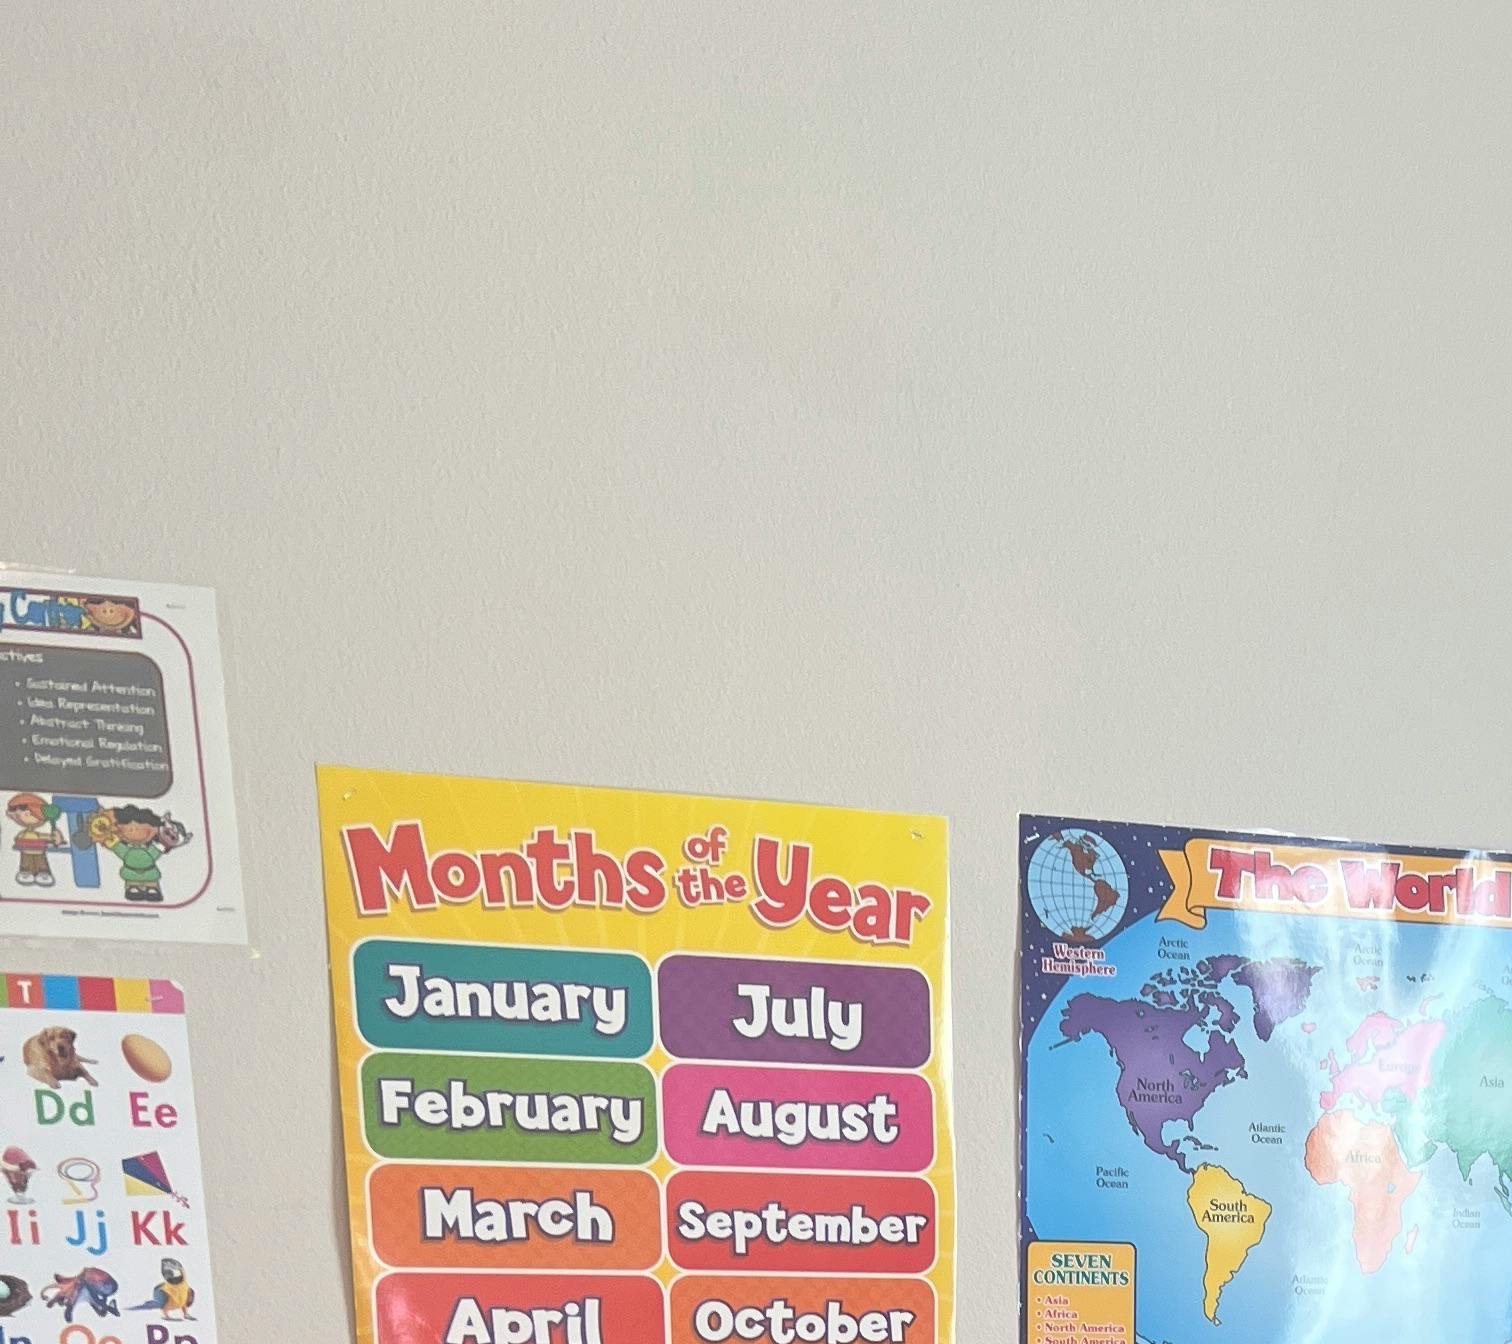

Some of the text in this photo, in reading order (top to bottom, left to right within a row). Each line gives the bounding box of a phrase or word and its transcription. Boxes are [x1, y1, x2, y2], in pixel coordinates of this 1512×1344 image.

[92, 681, 156, 697] Attention
[344, 821, 932, 944] Months of the Year
[1210, 848, 1511, 917] The World
[1159, 936, 1188, 948] Arctic
[1053, 944, 1104, 959] Western
[1158, 949, 1189, 961] Ocean
[1354, 943, 1382, 956] Arctic
[1043, 958, 1116, 976] Hemisphere
[1353, 956, 1383, 967] Ocean
[17, 980, 32, 1003] T
[385, 964, 627, 1035] January
[733, 984, 862, 1050] July
[1136, 1078, 1175, 1092] North
[1479, 1076, 1505, 1089] Asia
[1128, 1090, 1183, 1104] America
[34, 1089, 178, 1128] Dd Ee
[379, 1079, 643, 1142] February
[703, 1090, 899, 1146] August
[1249, 1122, 1286, 1133] Atlantic
[1252, 1134, 1283, 1144] Ocean
[1344, 1151, 1382, 1164] Africa
[1096, 1166, 1129, 1177] Pacific
[1096, 1178, 1128, 1189] Ocean
[1210, 1199, 1247, 1212] South
[422, 1189, 612, 1243] March
[1202, 1211, 1255, 1224] America
[1452, 1208, 1481, 1219] Indian
[679, 1202, 926, 1255] September
[1452, 1219, 1481, 1229] Ocean
[7, 1210, 188, 1256] Ii Jj Kk
[1051, 1254, 1112, 1269] SEVEN
[1033, 1270, 1129, 1285] CONTINENTS
[1044, 1296, 1069, 1305] Asia
[1044, 1309, 1078, 1319] Africa
[1045, 1323, 1125, 1333] North America
